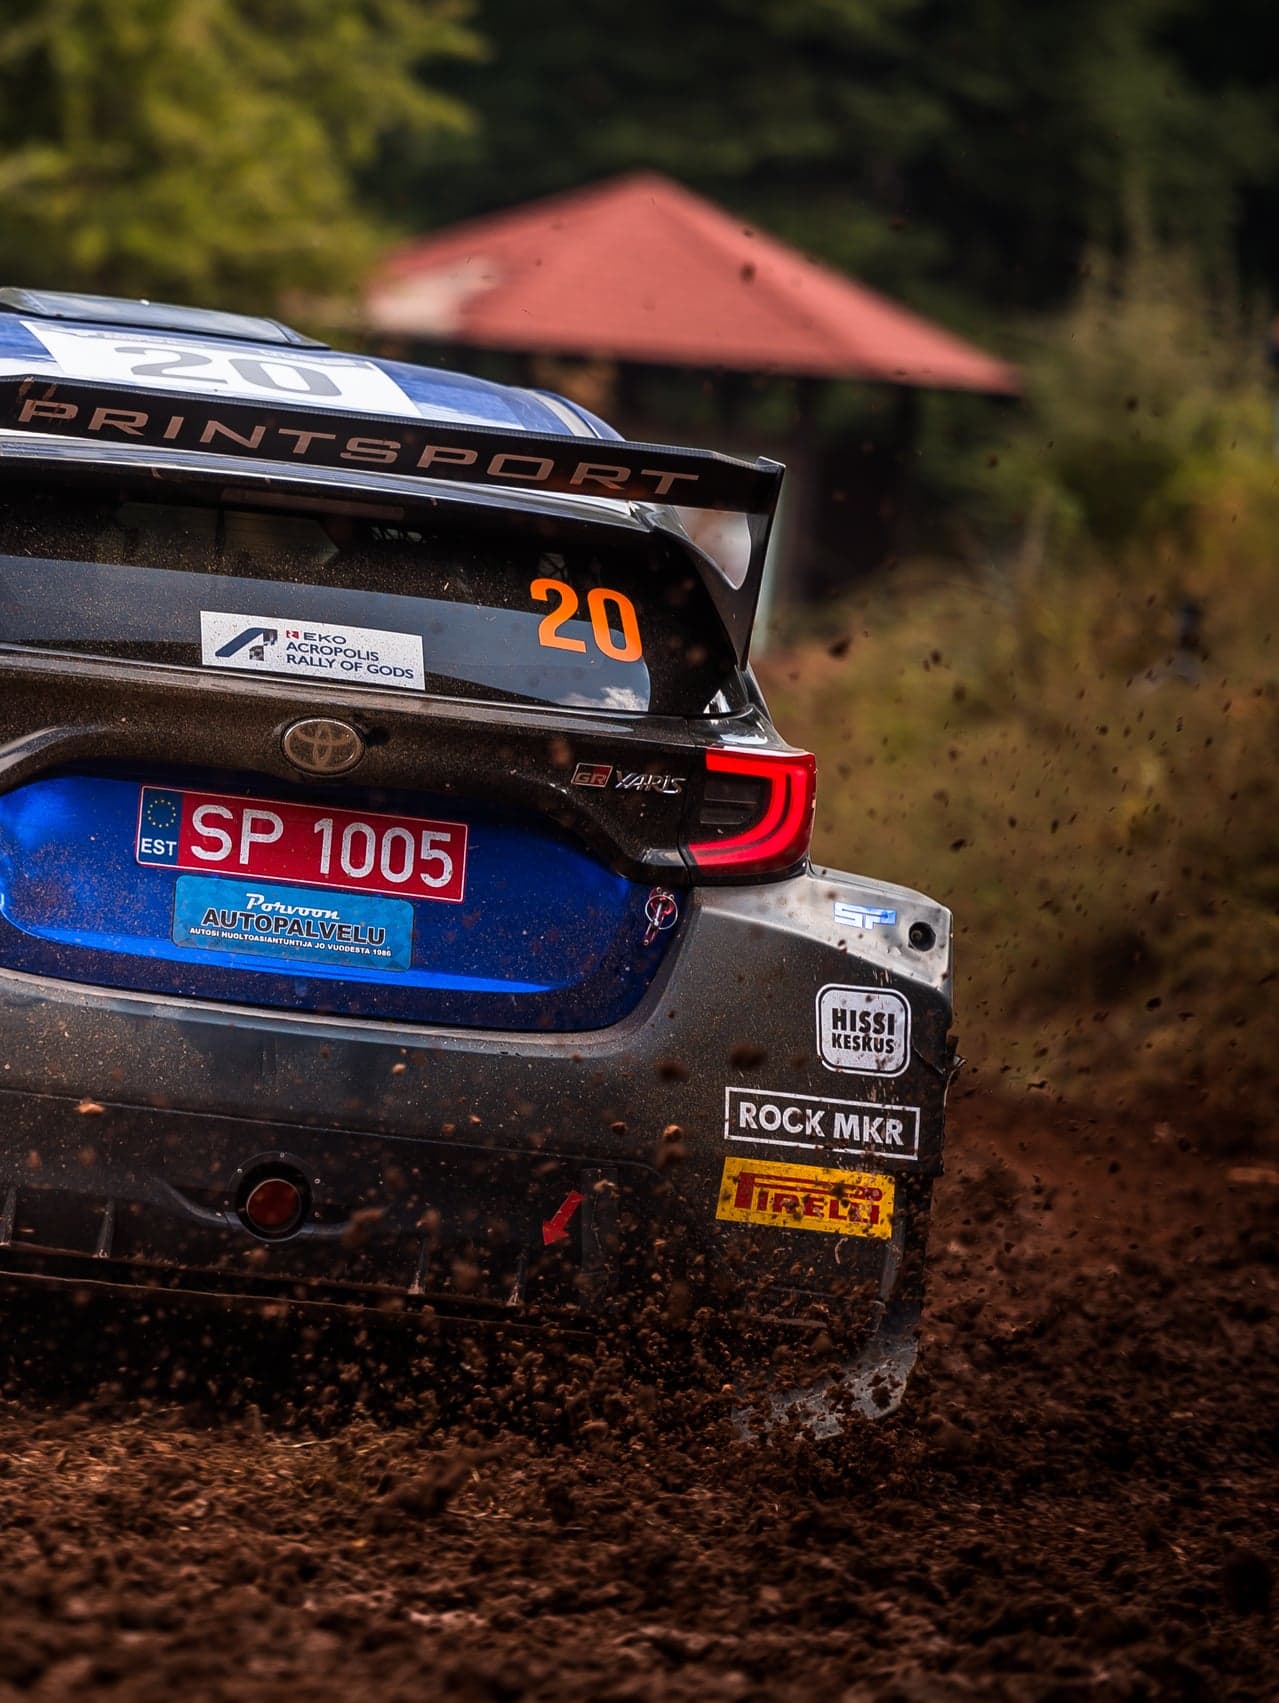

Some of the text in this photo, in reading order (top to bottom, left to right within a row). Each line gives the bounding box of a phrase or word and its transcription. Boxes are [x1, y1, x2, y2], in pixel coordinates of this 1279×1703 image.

[114, 346, 343, 397] 20
[17, 399, 700, 496] PRINTSPORT
[529, 577, 643, 664] 20
[286, 641, 380, 662] ACROPOLIS
[303, 632, 347, 645] EKO
[286, 653, 415, 679] RALLY OF GODS
[614, 769, 687, 795] YARIS
[141, 837, 177, 857] EST
[190, 803, 454, 888] SP 1005
[245, 892, 341, 921] Porvoon
[201, 907, 386, 946] AUTOPALVELU
[189, 927, 220, 938] AUTOSI
[221, 931, 313, 949] HUOLTOASIANTUNTIJA
[314, 942, 326, 950] JO
[327, 944, 371, 956] VUODESTA
[831, 1007, 896, 1036] HISSI
[831, 1032, 895, 1055] KESKUS
[738, 1101, 905, 1146] ROCK MKR
[733, 1170, 883, 1226] PIRELLI
